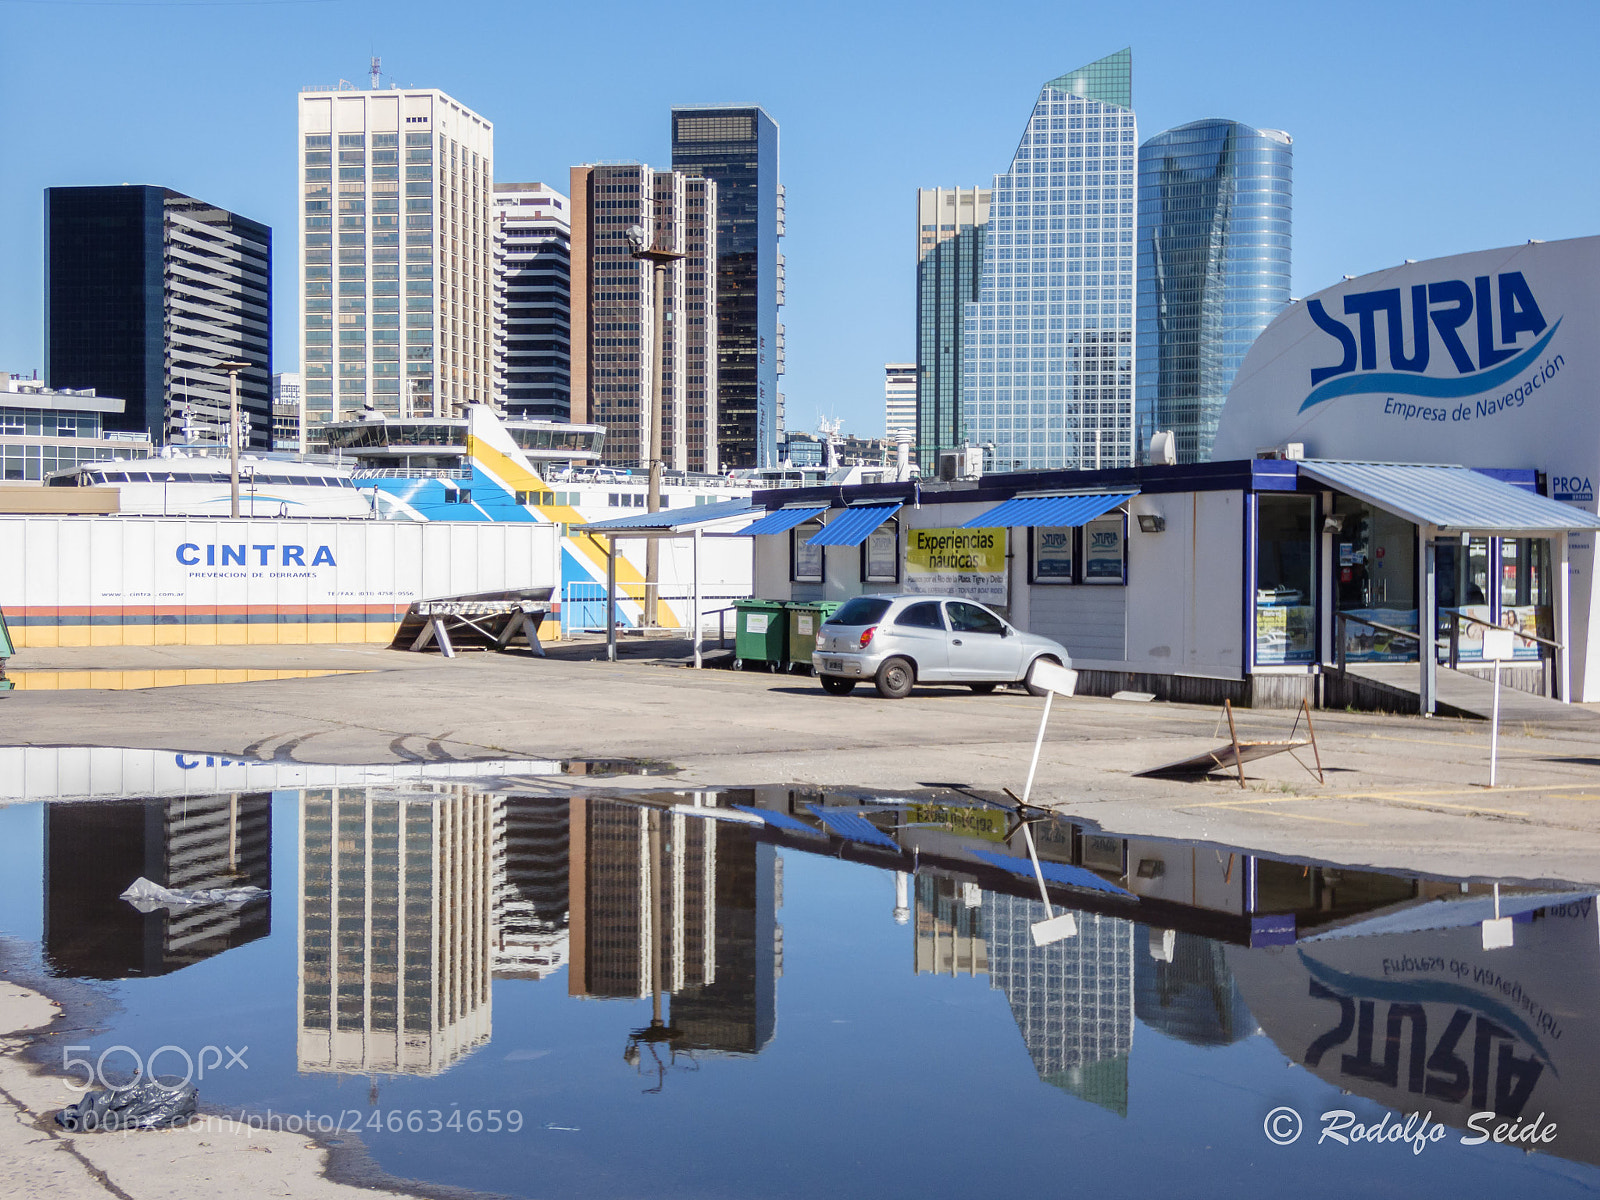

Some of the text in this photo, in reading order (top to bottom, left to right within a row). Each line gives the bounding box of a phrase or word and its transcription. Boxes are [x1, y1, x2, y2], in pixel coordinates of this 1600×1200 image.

[1307, 271, 1547, 387] STURLA
[1384, 353, 1565, 421] Empresa de Navegación
[1553, 476, 1593, 492] PROA
[917, 530, 994, 554] Experiencias
[175, 543, 337, 567] CINTRA
[929, 550, 979, 568] náuticas
